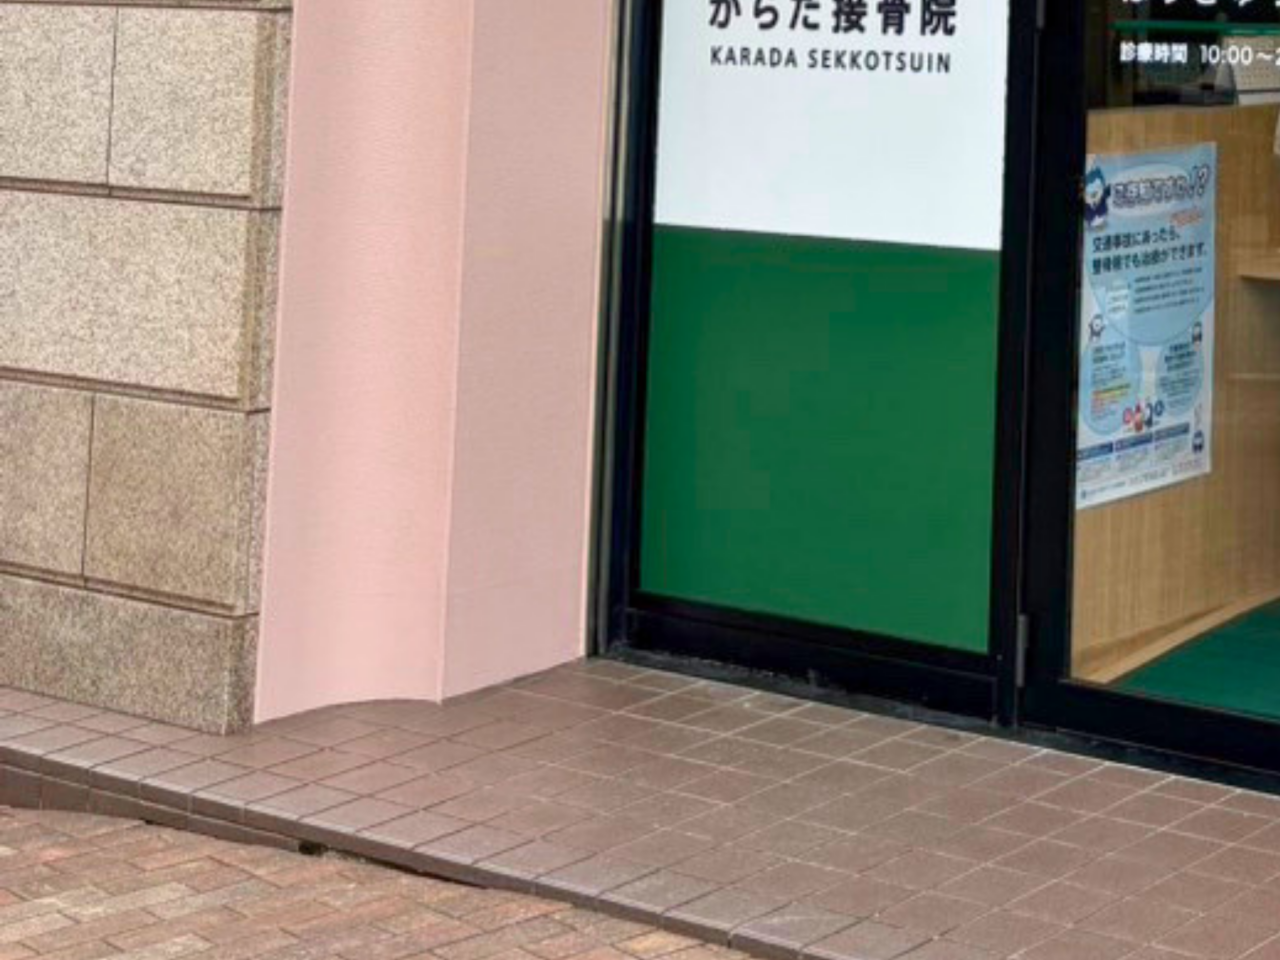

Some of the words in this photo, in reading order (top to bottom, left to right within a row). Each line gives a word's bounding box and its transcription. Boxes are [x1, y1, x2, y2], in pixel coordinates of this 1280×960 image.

[710, 46, 798, 68] KARADA
[808, 48, 951, 73] SEKKOTSUIN
[1119, 43, 1188, 63] 診療時間
